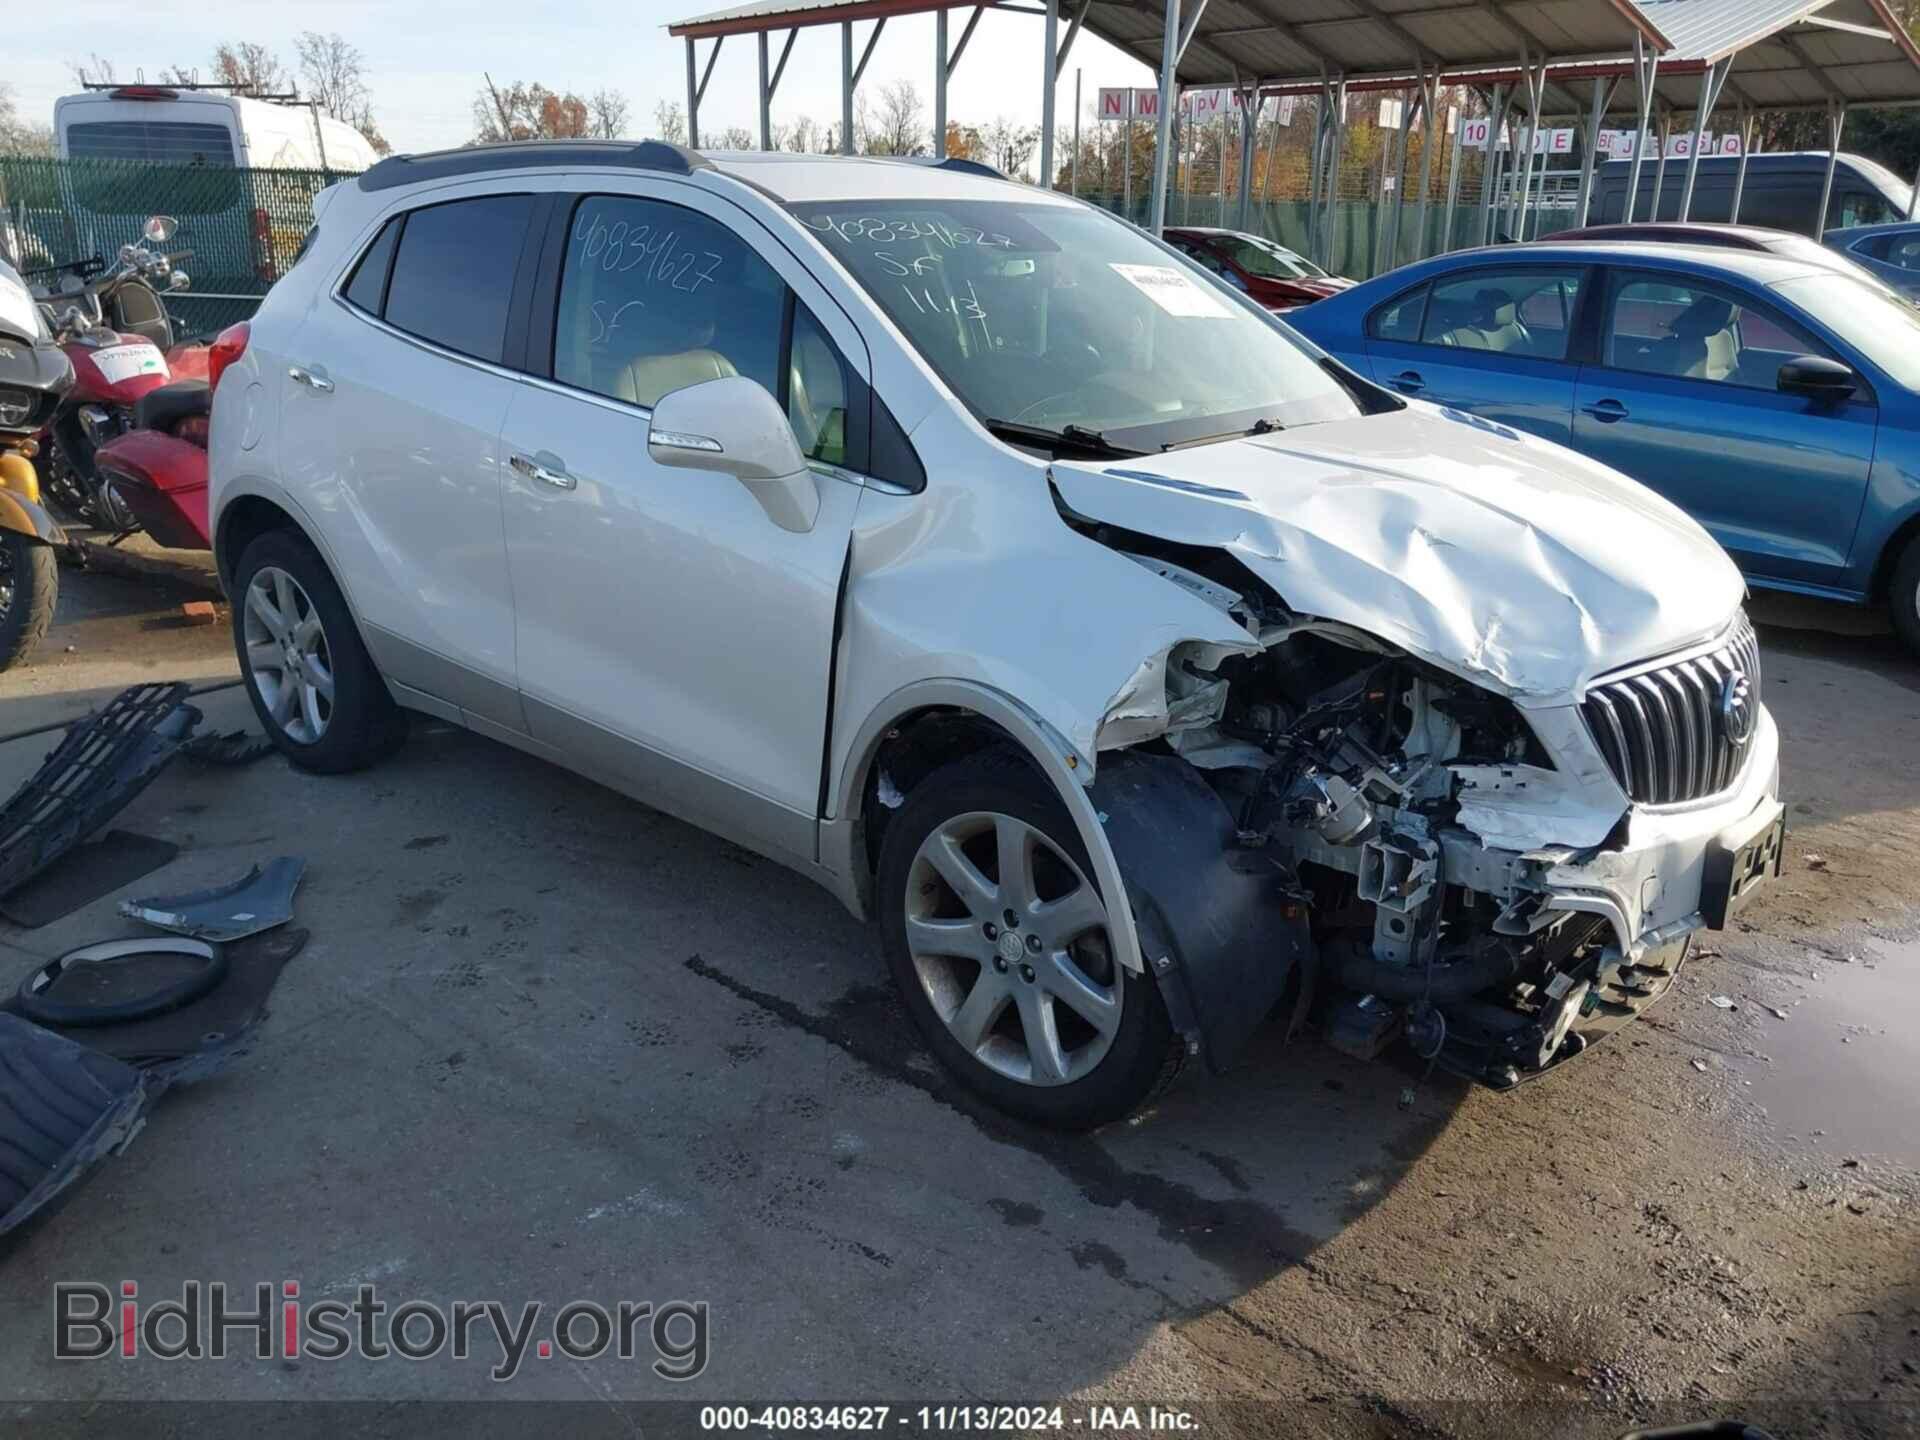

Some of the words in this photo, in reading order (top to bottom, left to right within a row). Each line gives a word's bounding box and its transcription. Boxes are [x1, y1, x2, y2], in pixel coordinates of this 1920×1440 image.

[1105, 94, 1121, 114] N
[1140, 94, 1157, 114] M
[1467, 124, 1486, 141] 10
[1555, 133, 1566, 149] E
[1623, 139, 1632, 154] J
[1675, 139, 1687, 154] G
[1725, 138, 1738, 153] Q
[575, 213, 723, 293] 40834627
